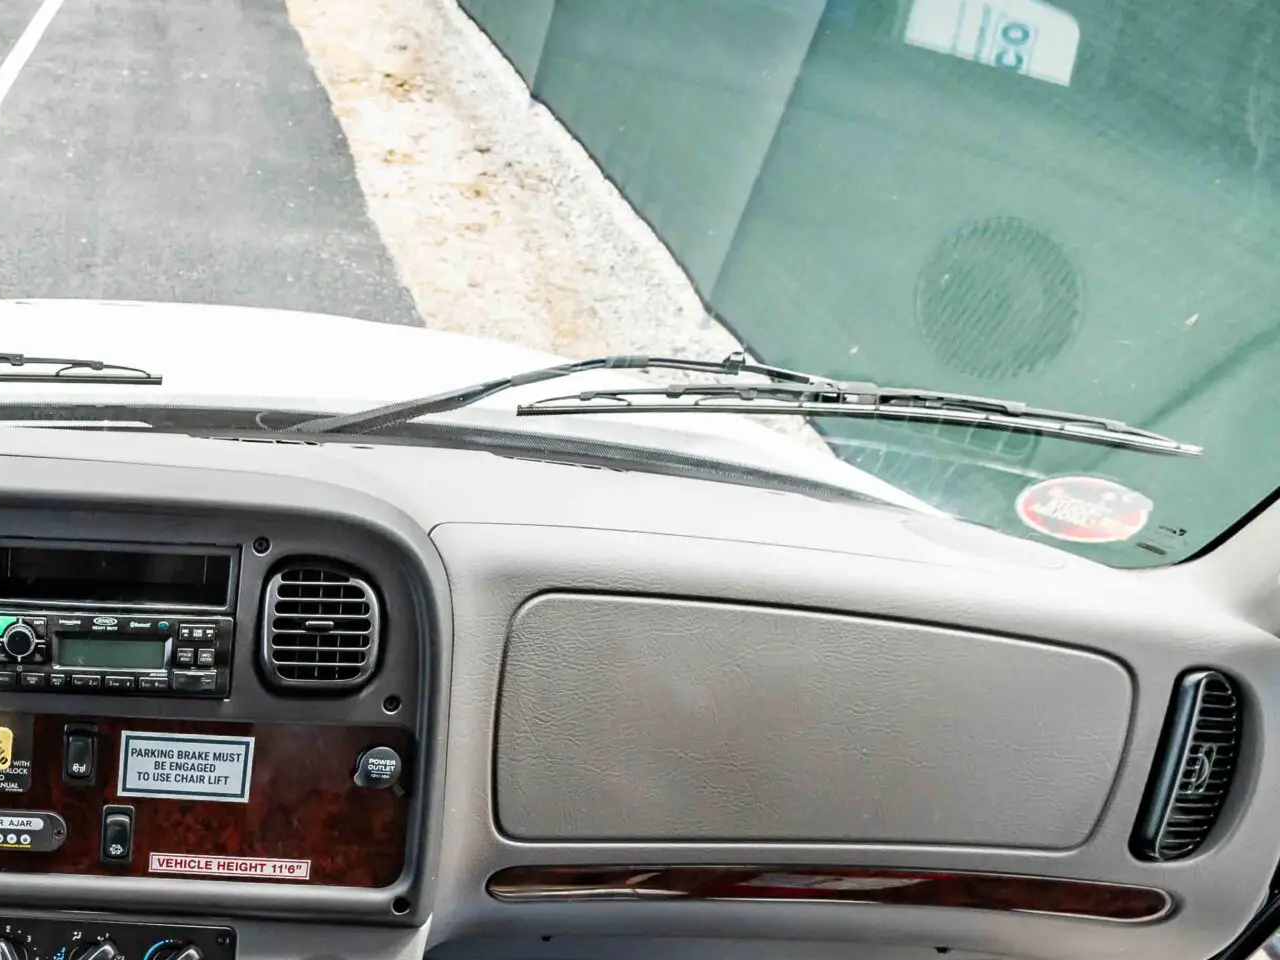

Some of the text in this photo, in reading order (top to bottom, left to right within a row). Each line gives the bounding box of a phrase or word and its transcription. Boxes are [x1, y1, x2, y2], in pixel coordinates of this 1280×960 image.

[131, 748, 242, 763] PARKING BRAKE MUST
[154, 761, 216, 773] BE ENGAGED
[369, 758, 396, 766] POWER
[137, 771, 230, 785] TO USE CHAIR LIFT
[157, 858, 302, 874] VEHICLE HEIGHT 11'6"
[5, 925, 11, 933] 2
[26, 935, 32, 943] 3
